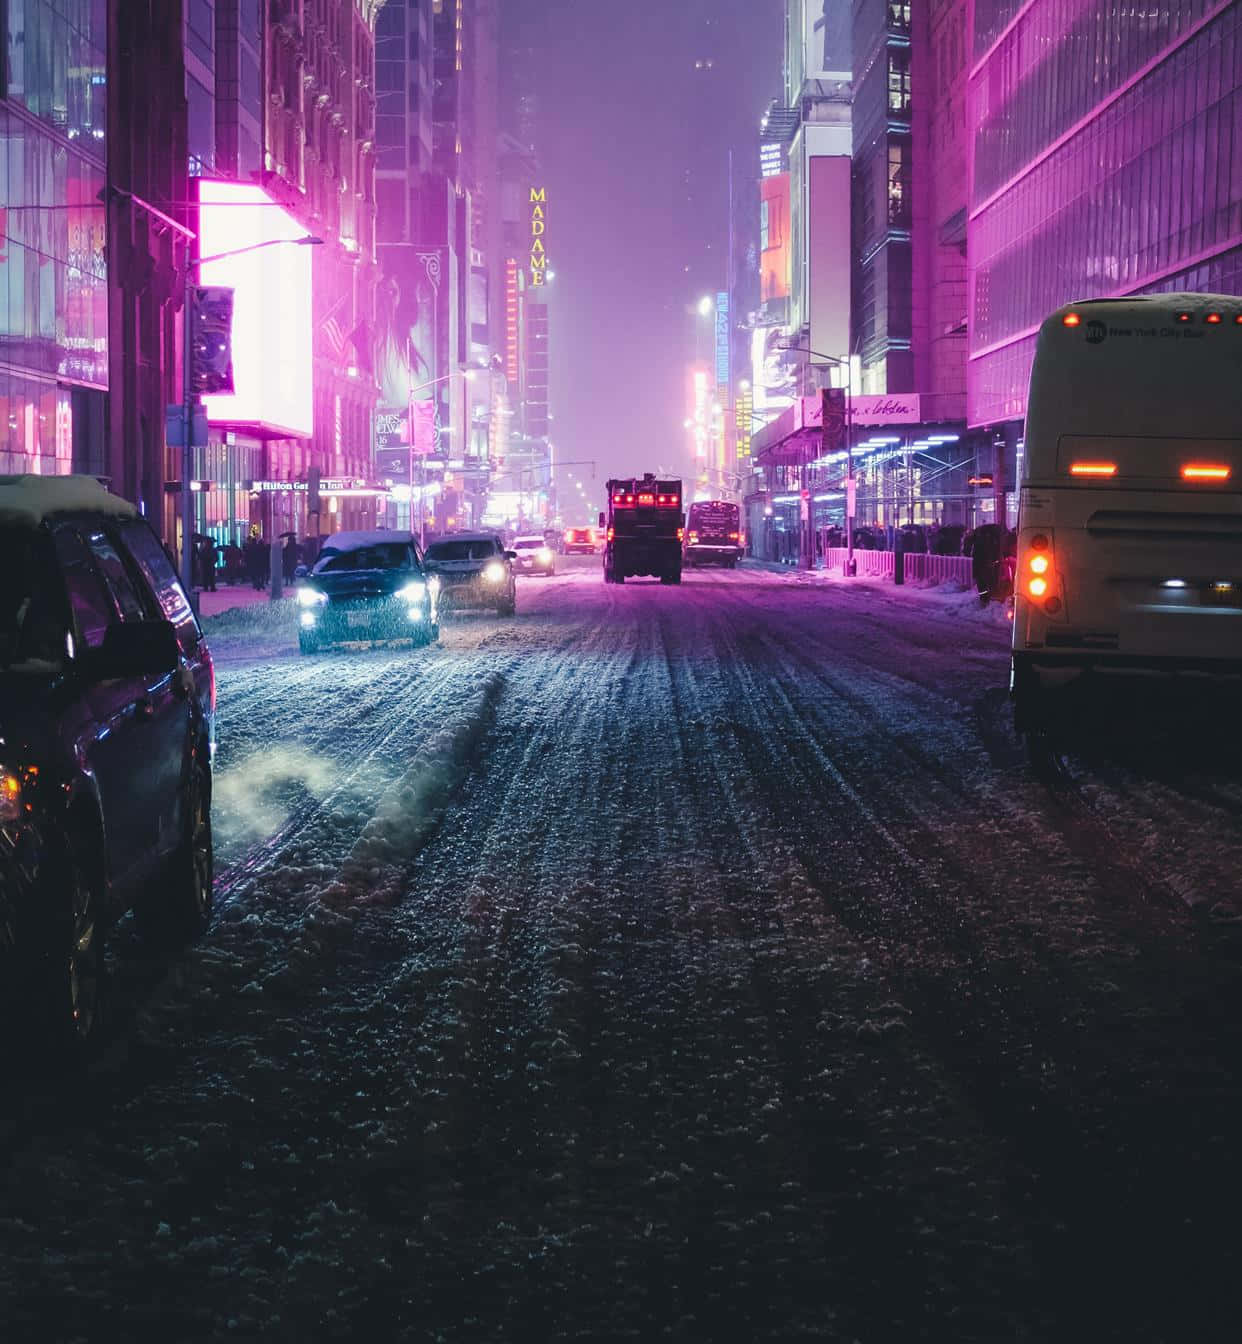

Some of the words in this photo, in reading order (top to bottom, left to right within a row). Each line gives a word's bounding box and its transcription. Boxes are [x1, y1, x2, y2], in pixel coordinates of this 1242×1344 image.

[530, 188, 546, 286] MADAME
[263, 481, 293, 490] Hilton
[293, 481, 326, 490] Garn
[328, 481, 344, 490] Inn
